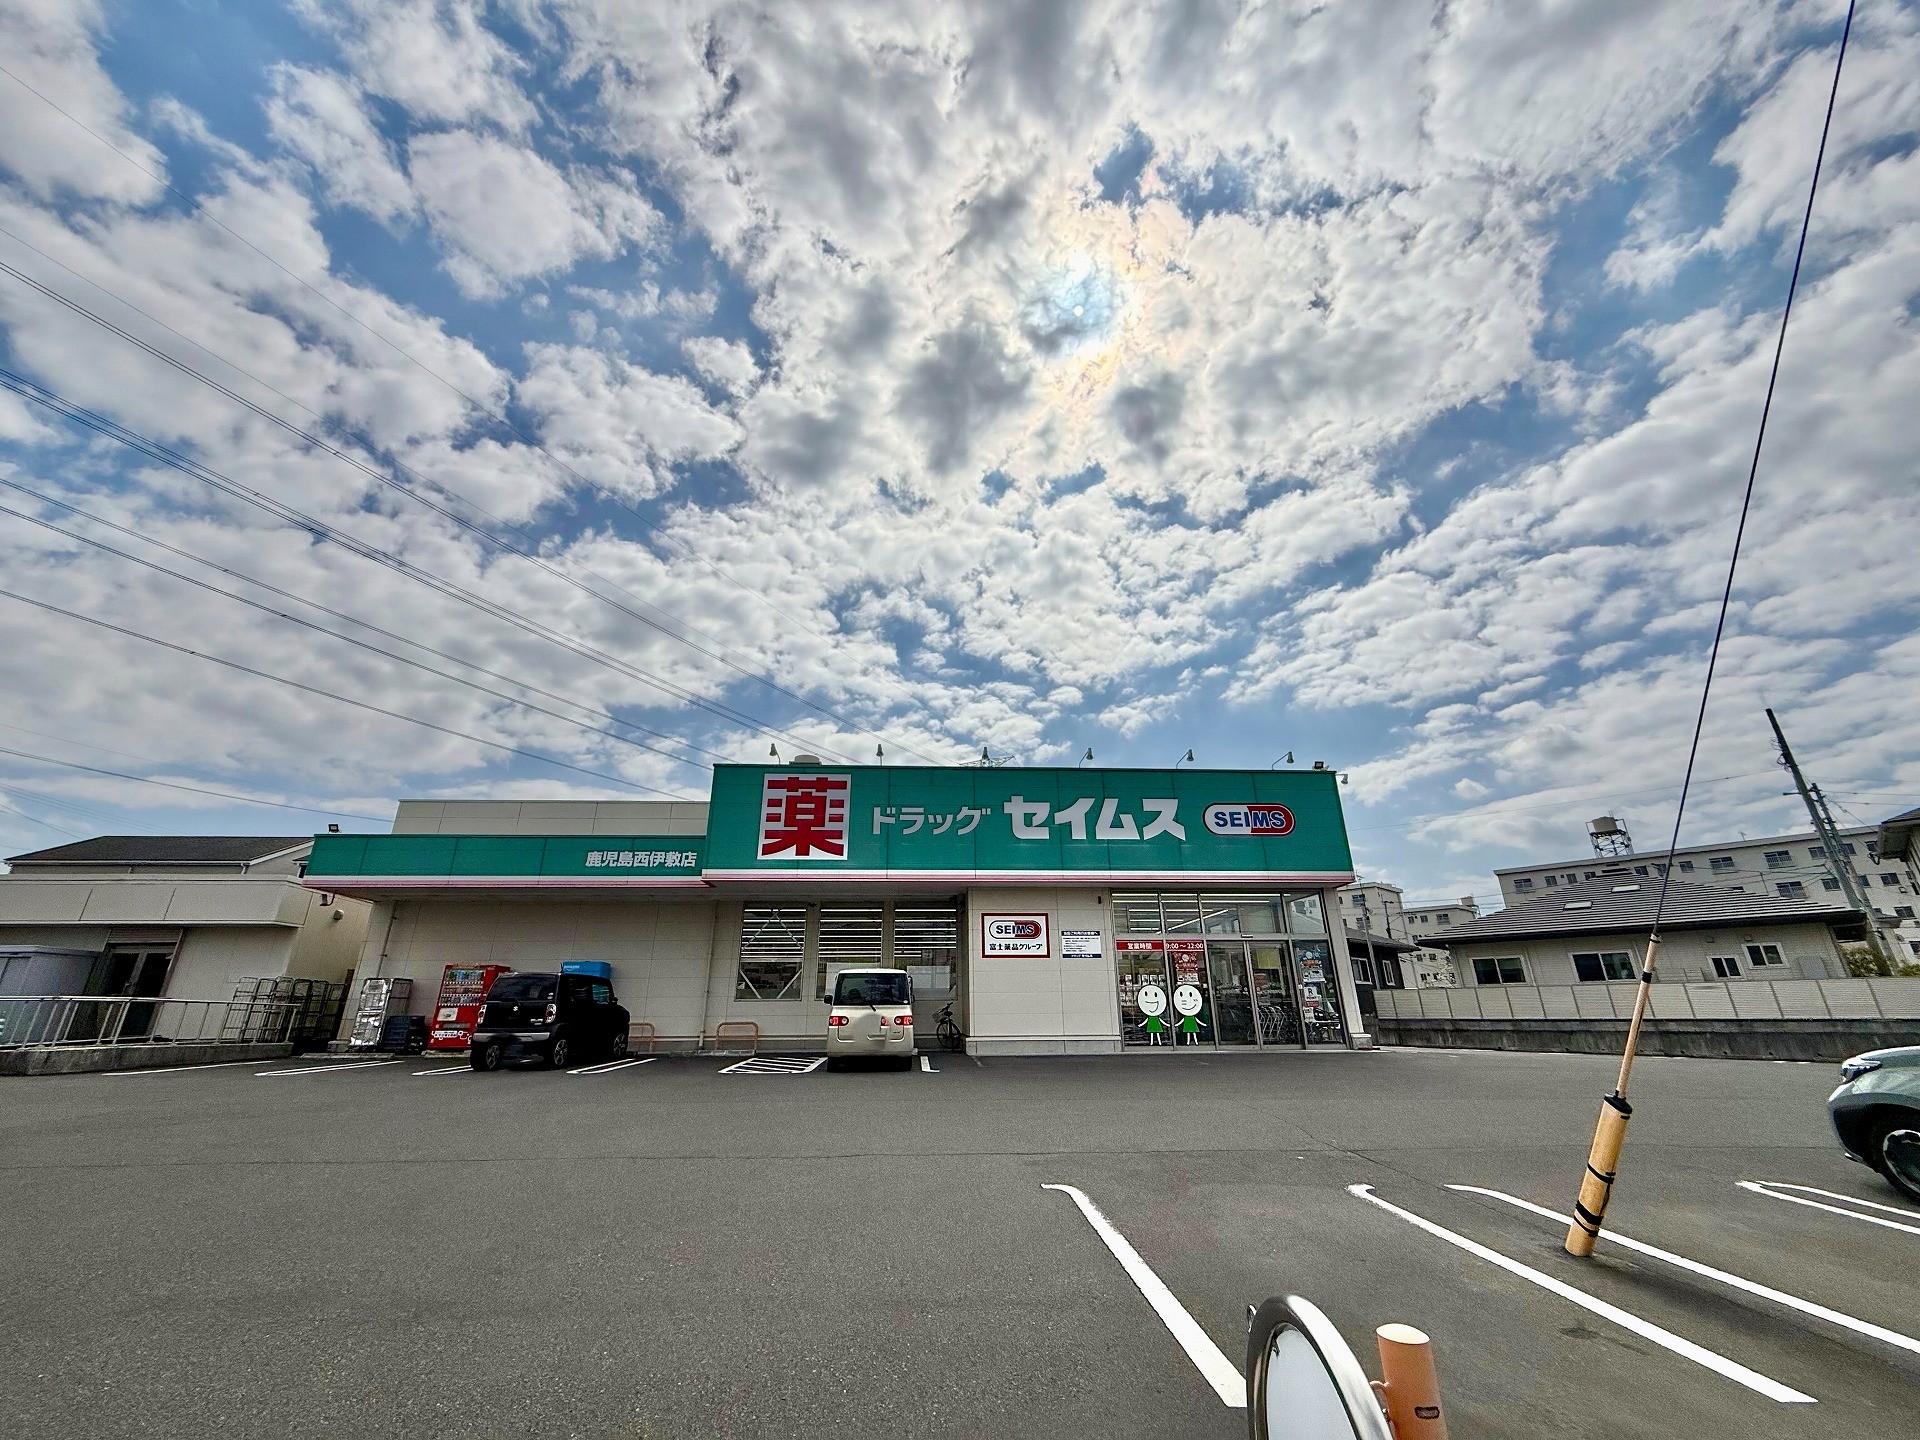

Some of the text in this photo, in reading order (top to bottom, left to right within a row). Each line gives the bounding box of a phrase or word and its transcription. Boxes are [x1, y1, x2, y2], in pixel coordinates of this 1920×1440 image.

[761, 776, 848, 857] 薬
[872, 795, 1186, 841] ドラッグ セイムス
[1213, 810, 1286, 829] SEIMS
[585, 850, 697, 867] 鹿児島西伊敷店
[995, 924, 1035, 935] SEIMS
[989, 943, 1043, 951] 富士薬品グループ
[1127, 942, 1152, 950] 営業時間
